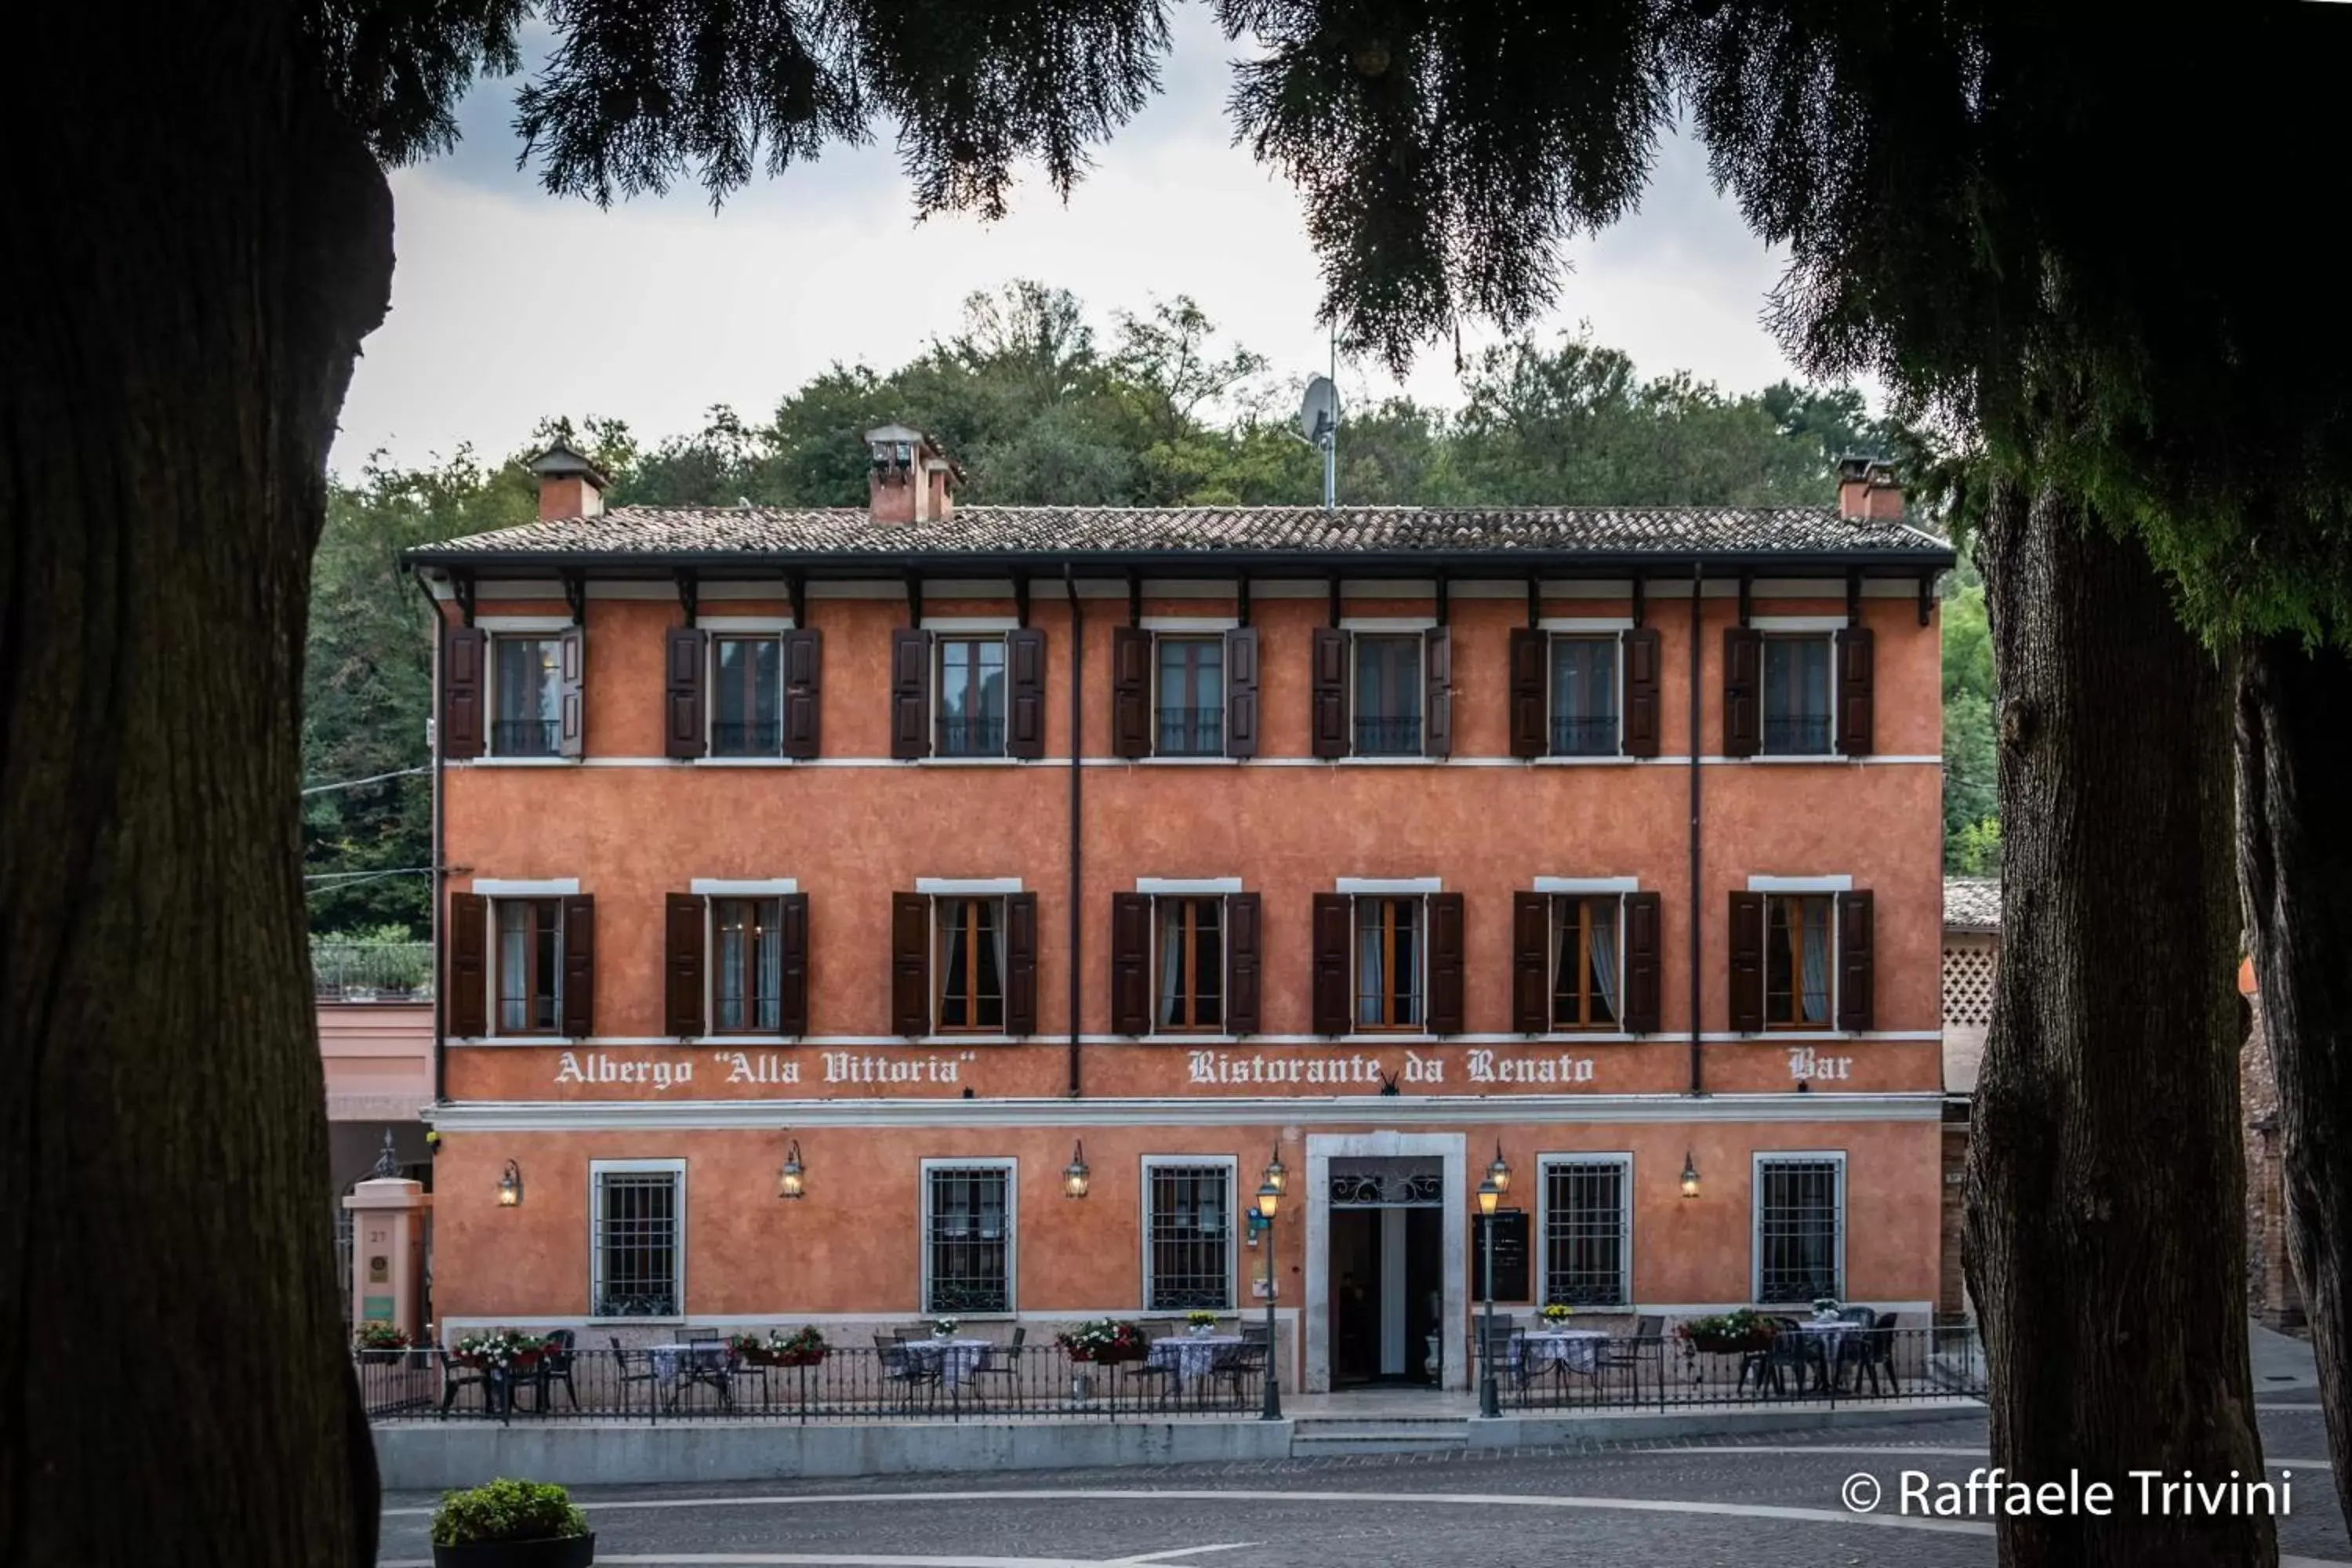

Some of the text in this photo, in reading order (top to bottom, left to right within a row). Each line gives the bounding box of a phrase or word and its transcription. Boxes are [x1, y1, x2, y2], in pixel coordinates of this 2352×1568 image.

[554, 1051, 694, 1091] Albergo
[1187, 1048, 1594, 1084] Ristorante da Renato
[1787, 1046, 1853, 1080] Bar
